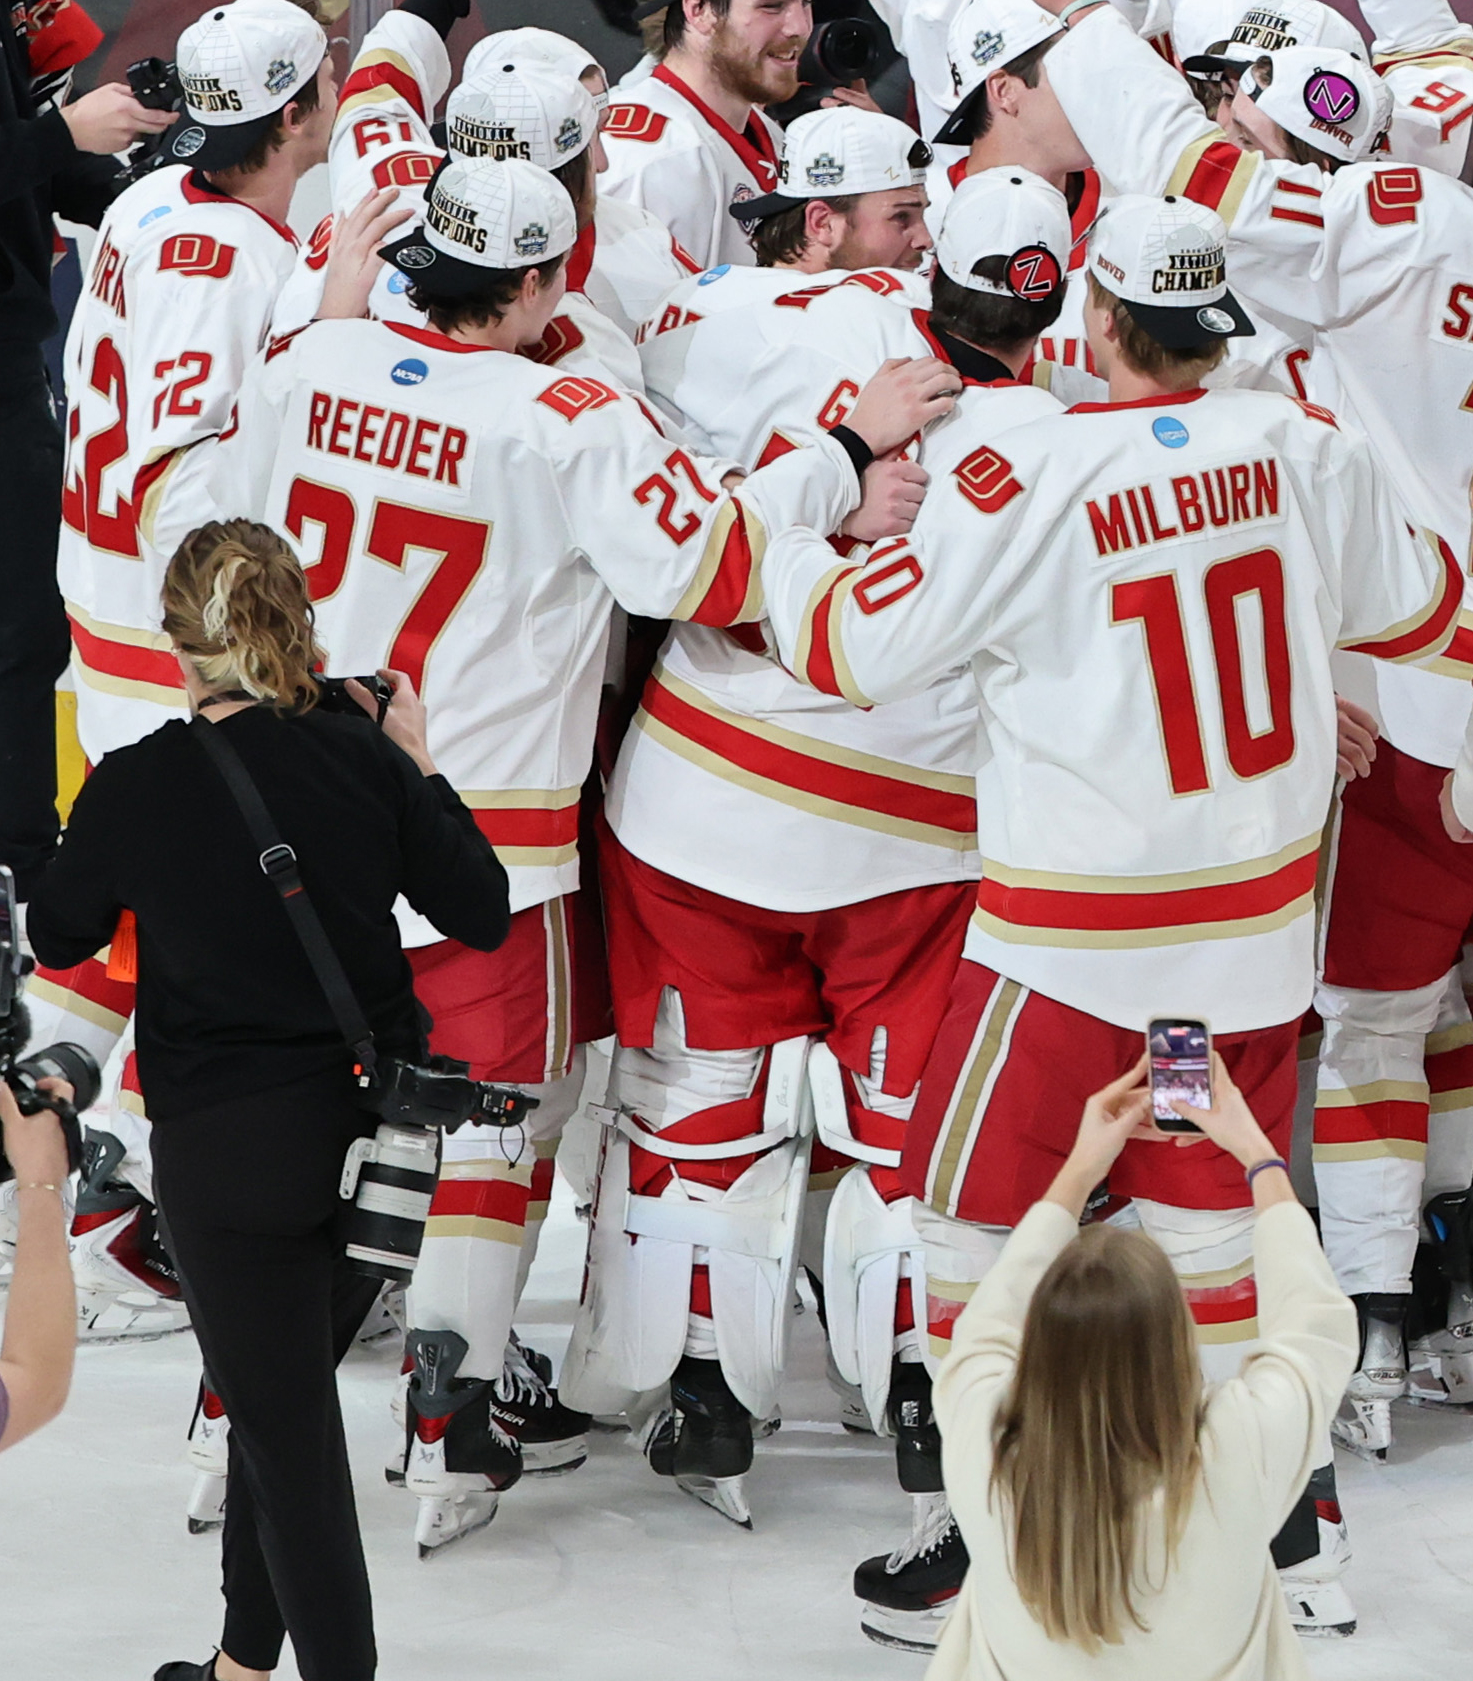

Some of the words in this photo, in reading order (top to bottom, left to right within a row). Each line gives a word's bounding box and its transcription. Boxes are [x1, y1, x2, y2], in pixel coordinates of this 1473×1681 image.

[392, 367, 425, 384] NCAA
[306, 389, 471, 488] REEDER
[1084, 458, 1282, 559] MILBURN
[284, 472, 495, 701] 27
[1107, 544, 1298, 801] 10
